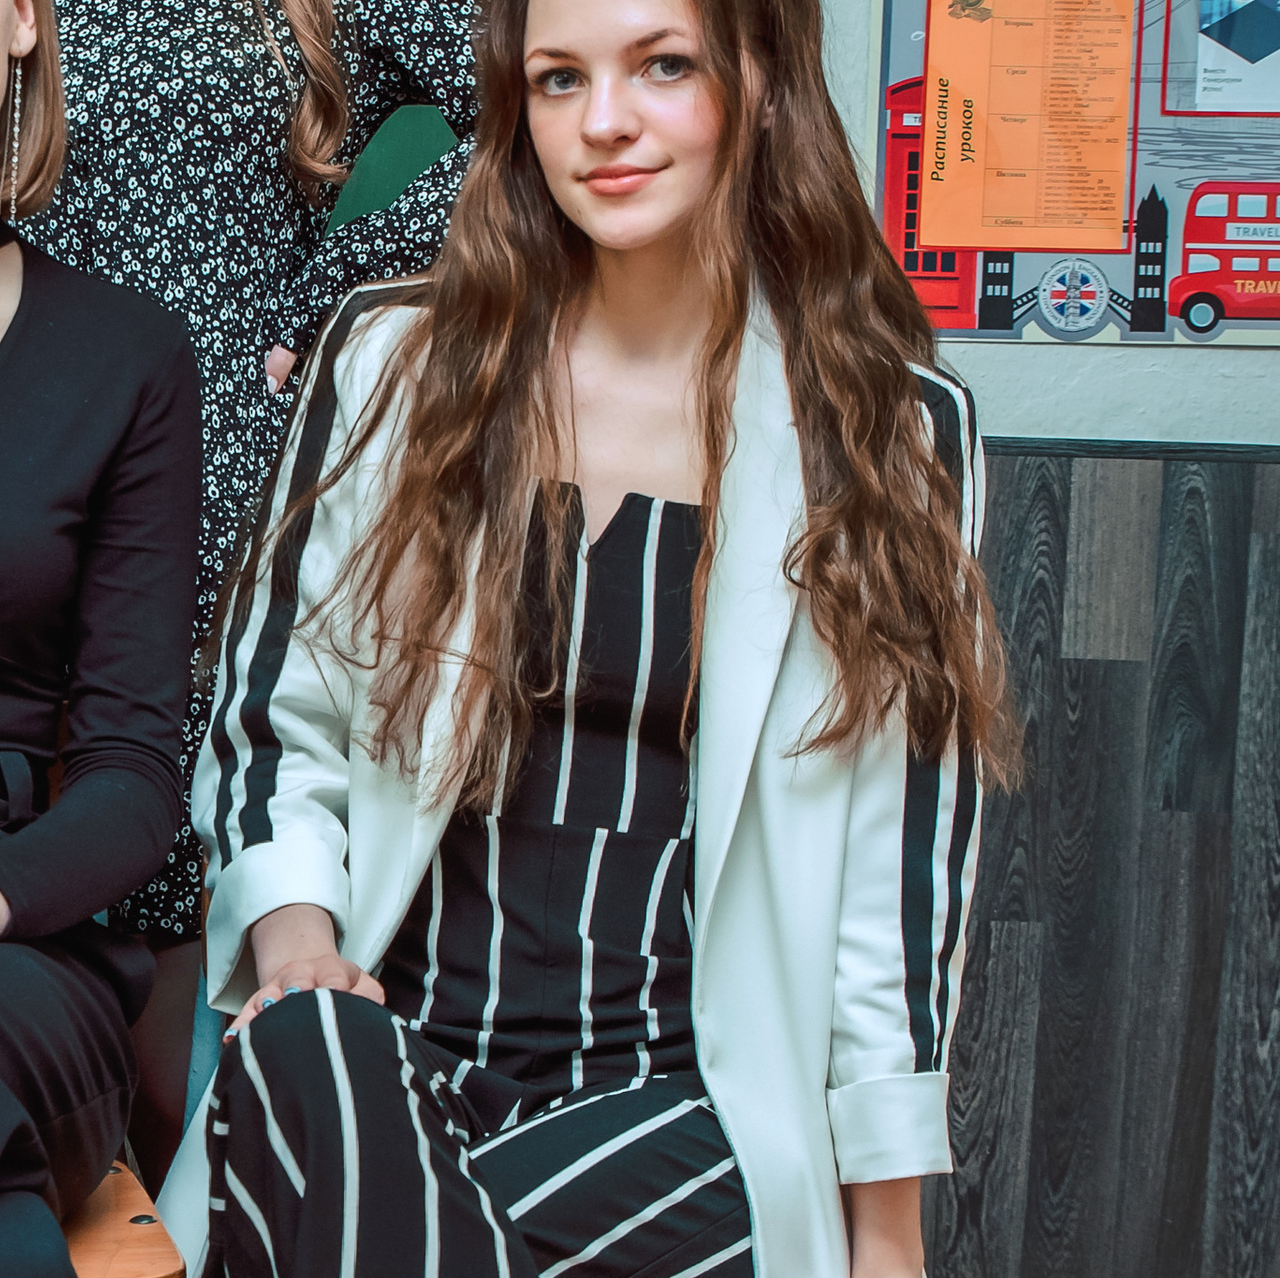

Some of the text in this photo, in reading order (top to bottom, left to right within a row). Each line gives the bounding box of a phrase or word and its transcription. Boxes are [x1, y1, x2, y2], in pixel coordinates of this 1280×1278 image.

[930, 77, 950, 182] Расписание
[960, 98, 976, 163] уроков
[1234, 226, 1280, 238] TRAVEL
